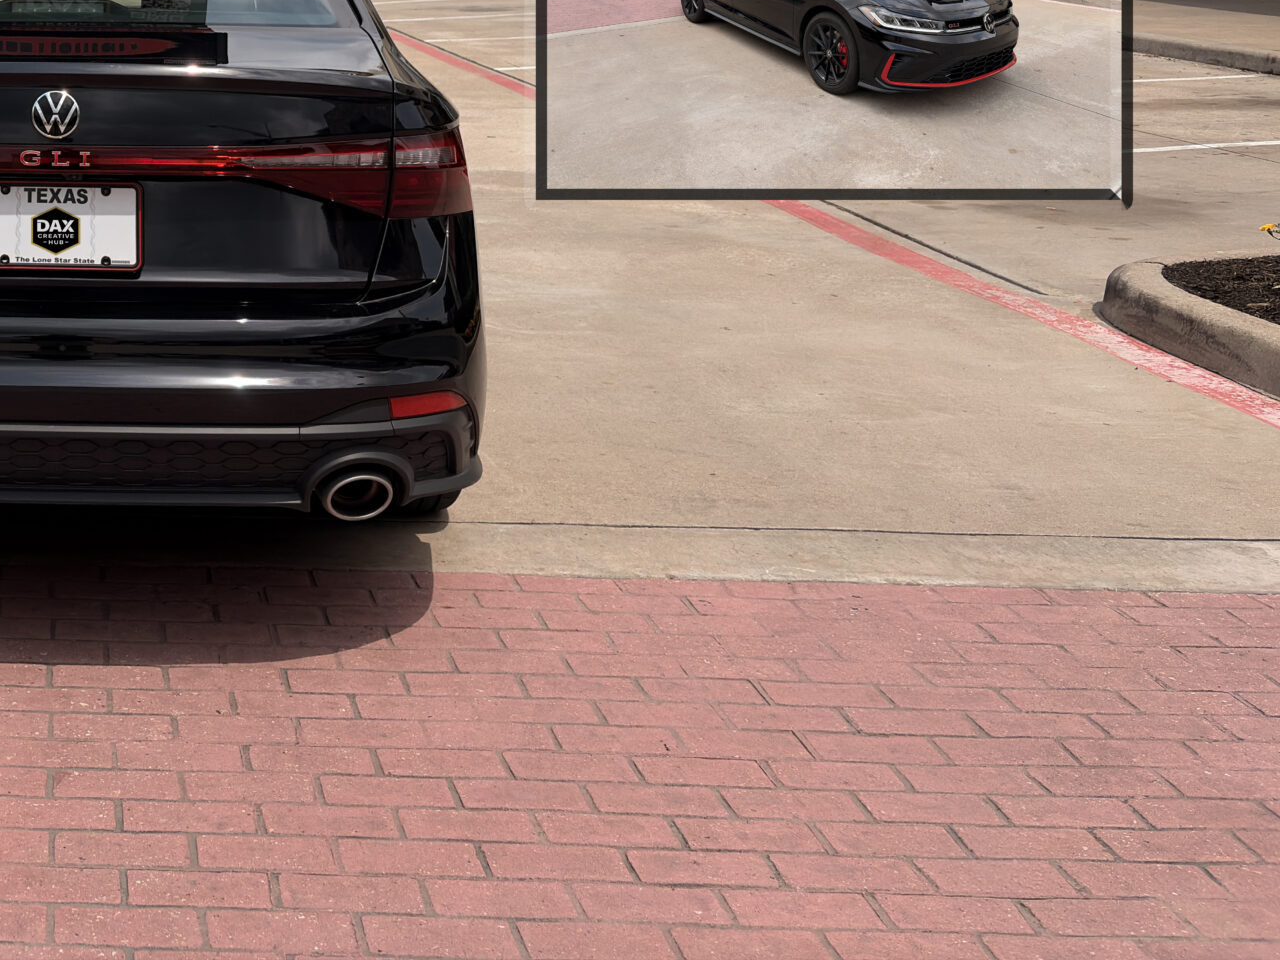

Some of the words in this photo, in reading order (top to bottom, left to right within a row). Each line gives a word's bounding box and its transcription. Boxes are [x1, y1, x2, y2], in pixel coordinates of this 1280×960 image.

[20, 150, 91, 167] GLI
[24, 187, 89, 205] TEXAS
[36, 219, 75, 233] DAX
